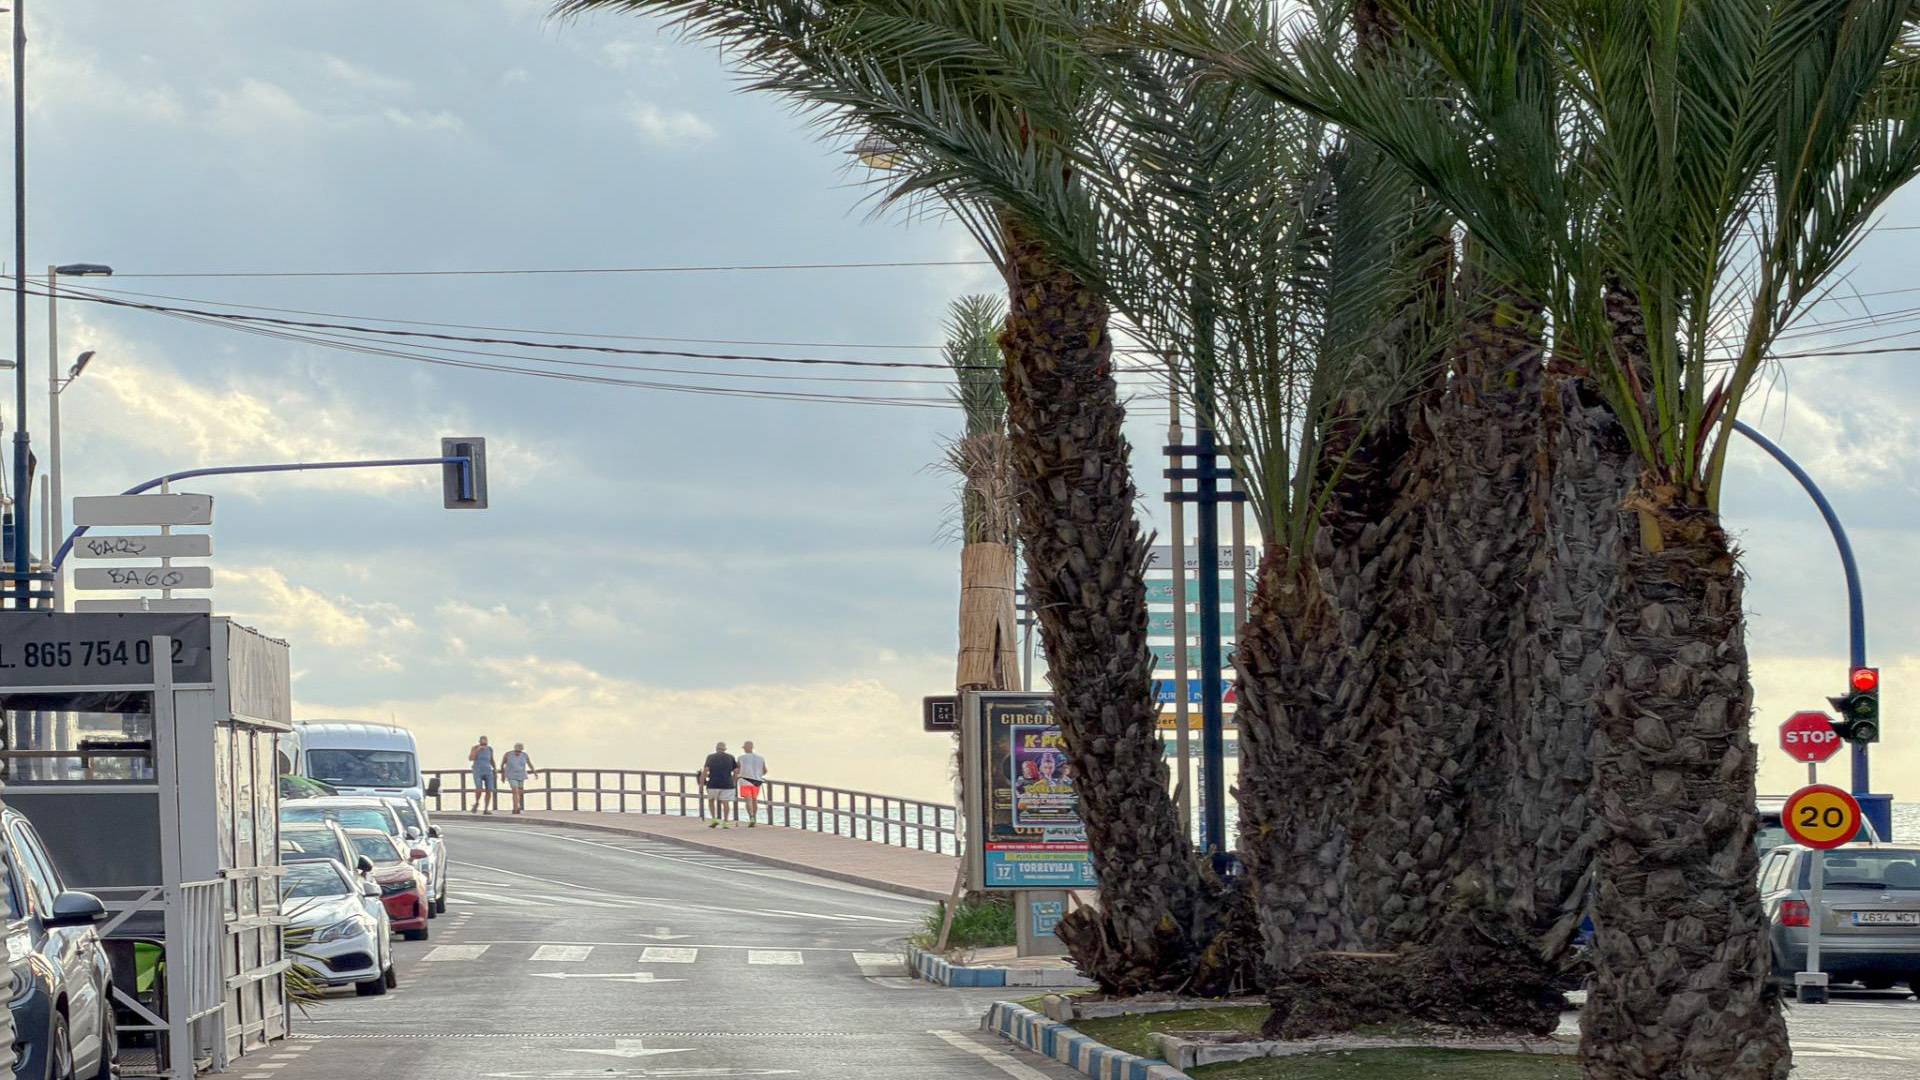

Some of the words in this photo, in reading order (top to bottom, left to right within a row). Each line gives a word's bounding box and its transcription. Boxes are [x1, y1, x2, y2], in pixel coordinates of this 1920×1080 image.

[24, 641, 72, 667] 865
[80, 640, 129, 666] 754
[136, 638, 184, 665] 02
[1001, 713, 1042, 725] CIRCO
[1785, 730, 1838, 744] STOP
[1799, 805, 1844, 829] 20
[998, 866, 1011, 877] 17
[1019, 862, 1075, 873] TORREVIEJA
